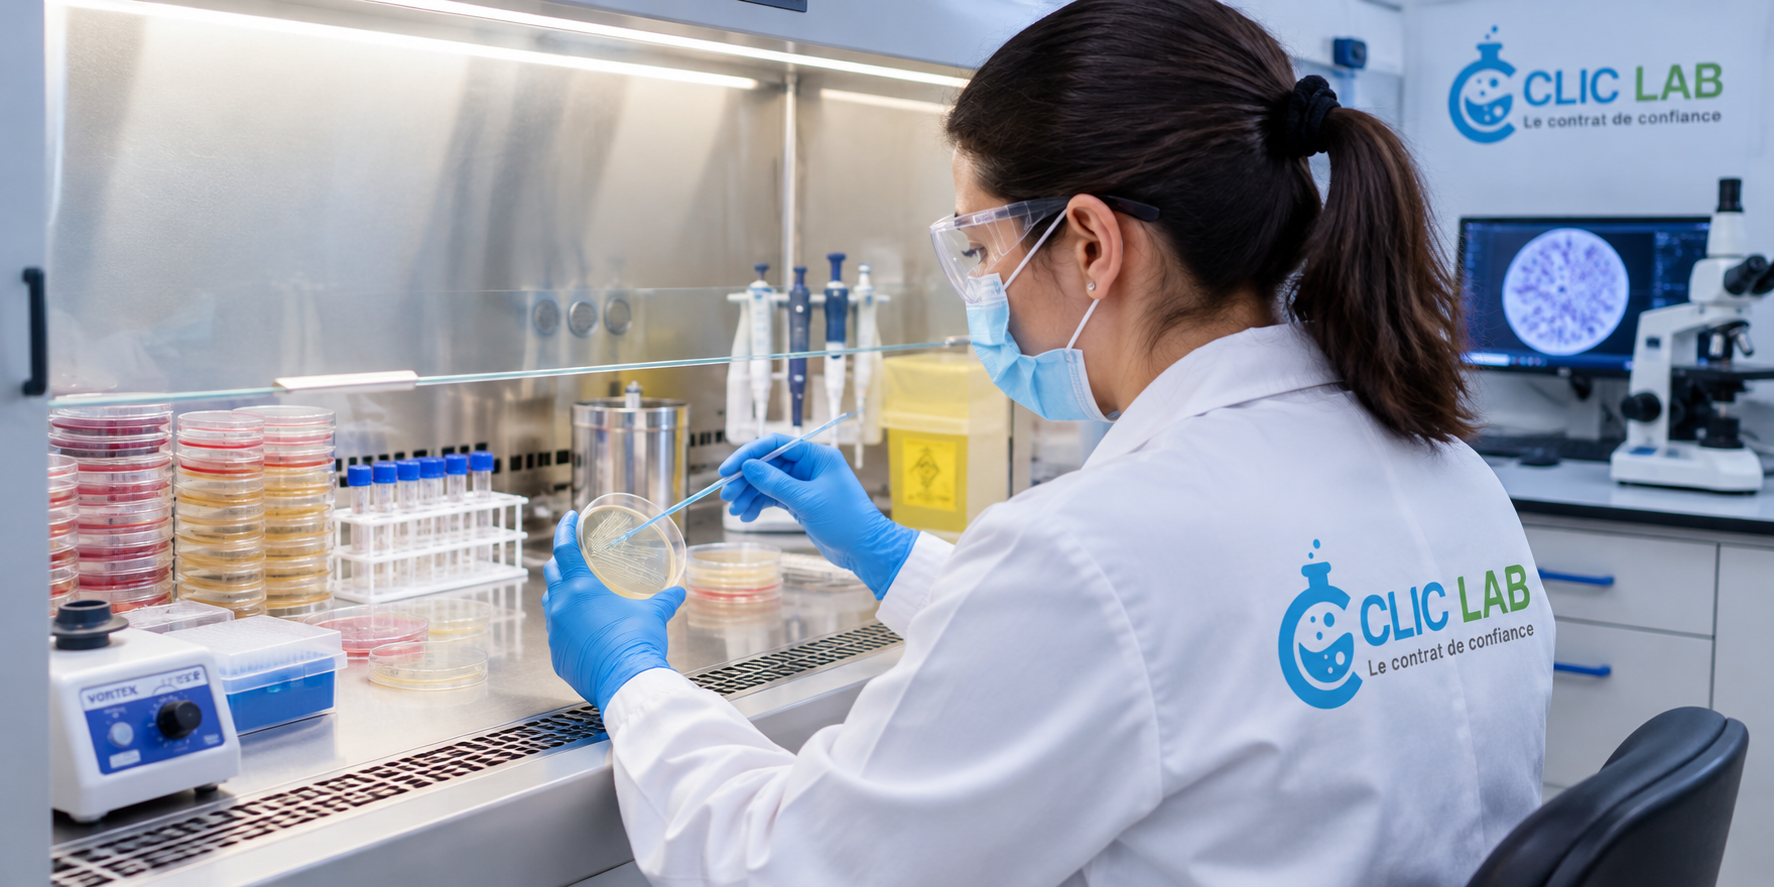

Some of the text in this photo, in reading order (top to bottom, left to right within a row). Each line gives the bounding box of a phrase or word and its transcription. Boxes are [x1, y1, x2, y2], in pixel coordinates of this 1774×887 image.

[1523, 62, 1724, 107] CLIC LAB
[1523, 109, 1722, 129] Le contrat de confiance
[1360, 564, 1531, 647] CLIC LAB
[1368, 624, 1534, 677] Le contrat de confiance
